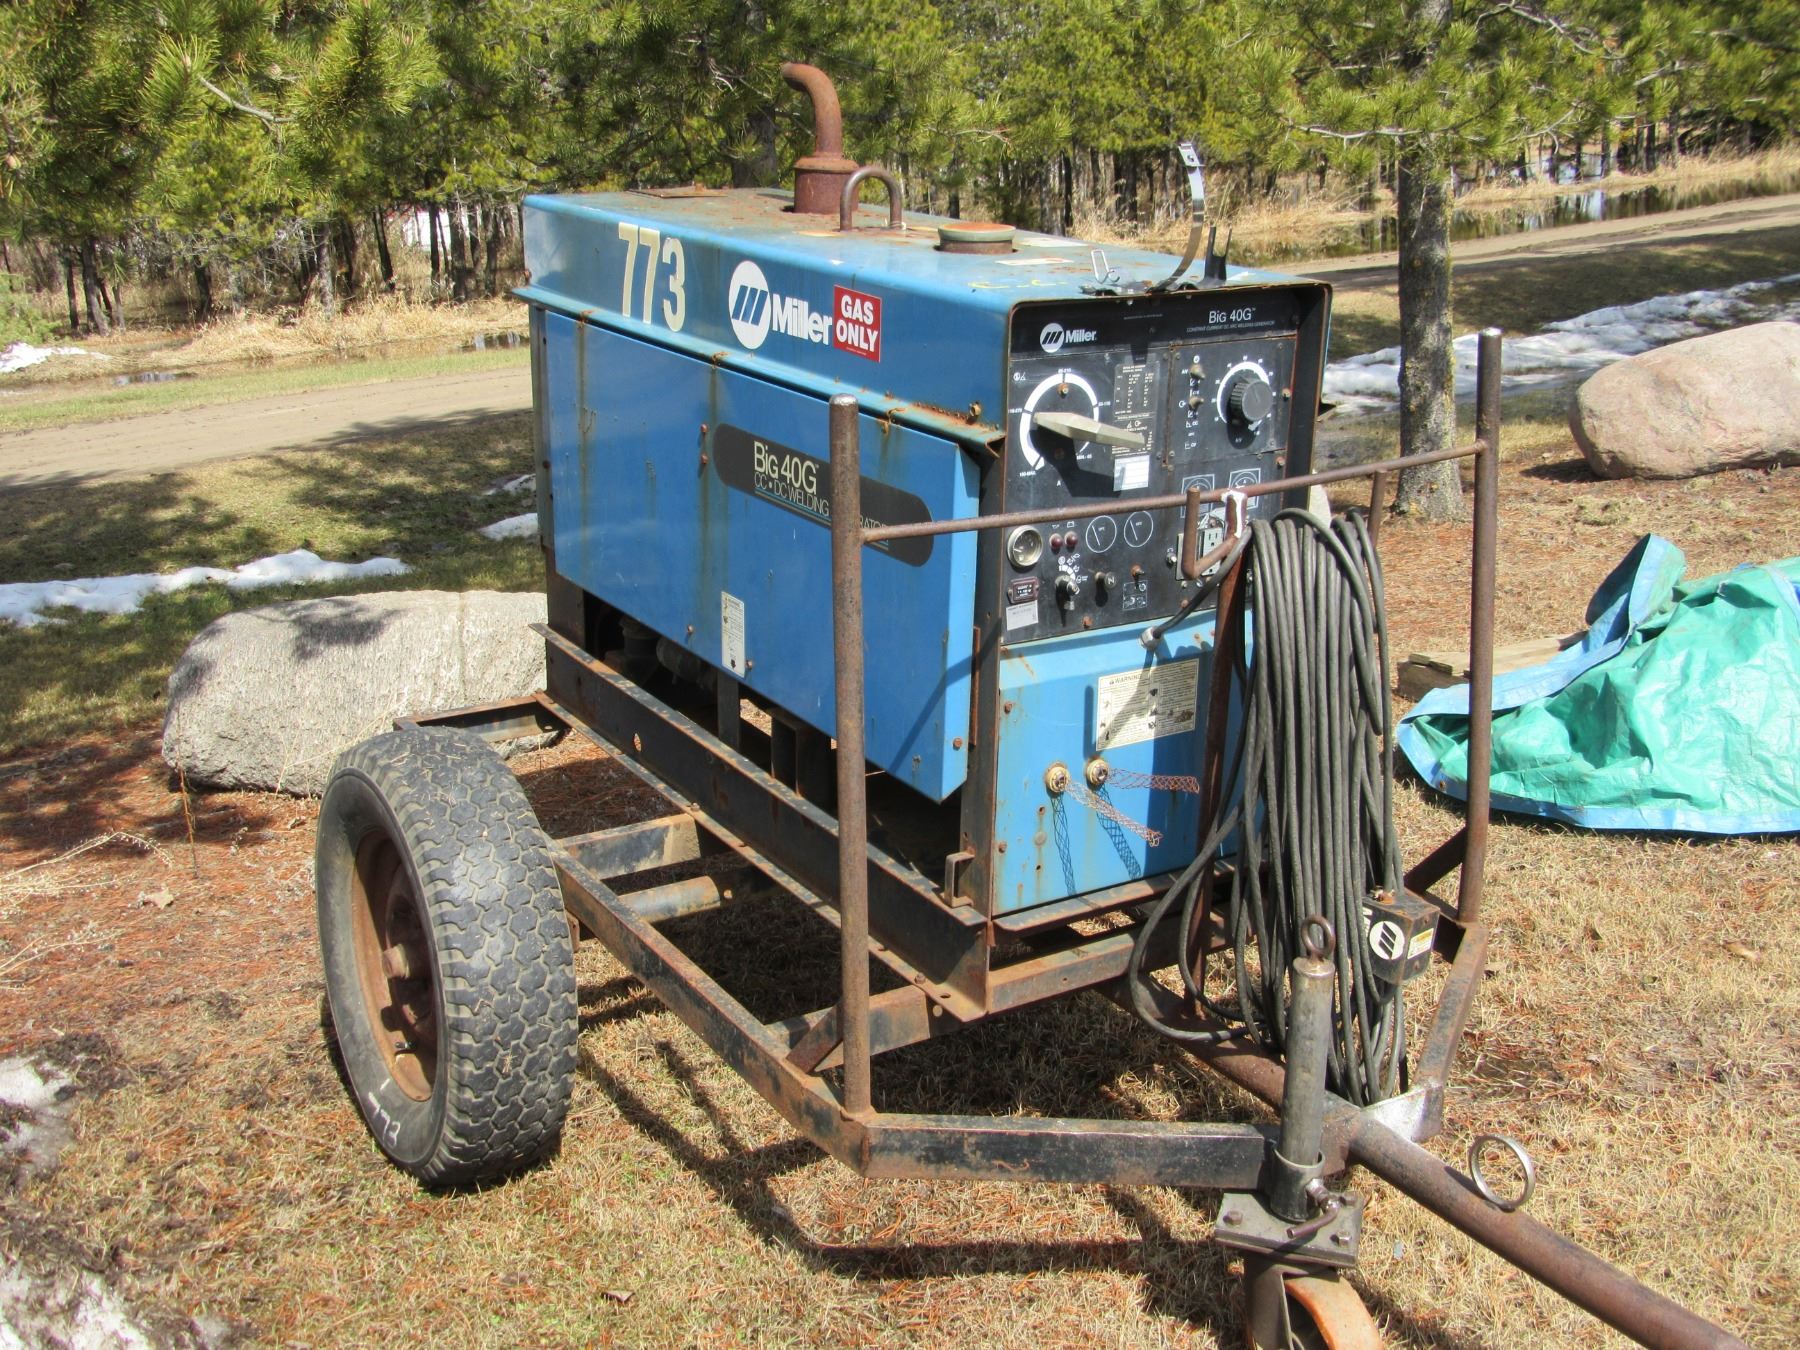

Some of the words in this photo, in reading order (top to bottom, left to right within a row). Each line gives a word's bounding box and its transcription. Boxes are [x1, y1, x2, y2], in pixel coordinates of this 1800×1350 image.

[618, 222, 685, 332] 773
[772, 293, 832, 345] Miller
[841, 295, 874, 325] GAS
[836, 319, 878, 352] ONLY
[1065, 328, 1097, 344] Miller
[780, 454, 817, 496] 40G
[774, 481, 788, 499] DC
[787, 487, 830, 517] WELDING
[1115, 674, 1142, 684] WARNING
